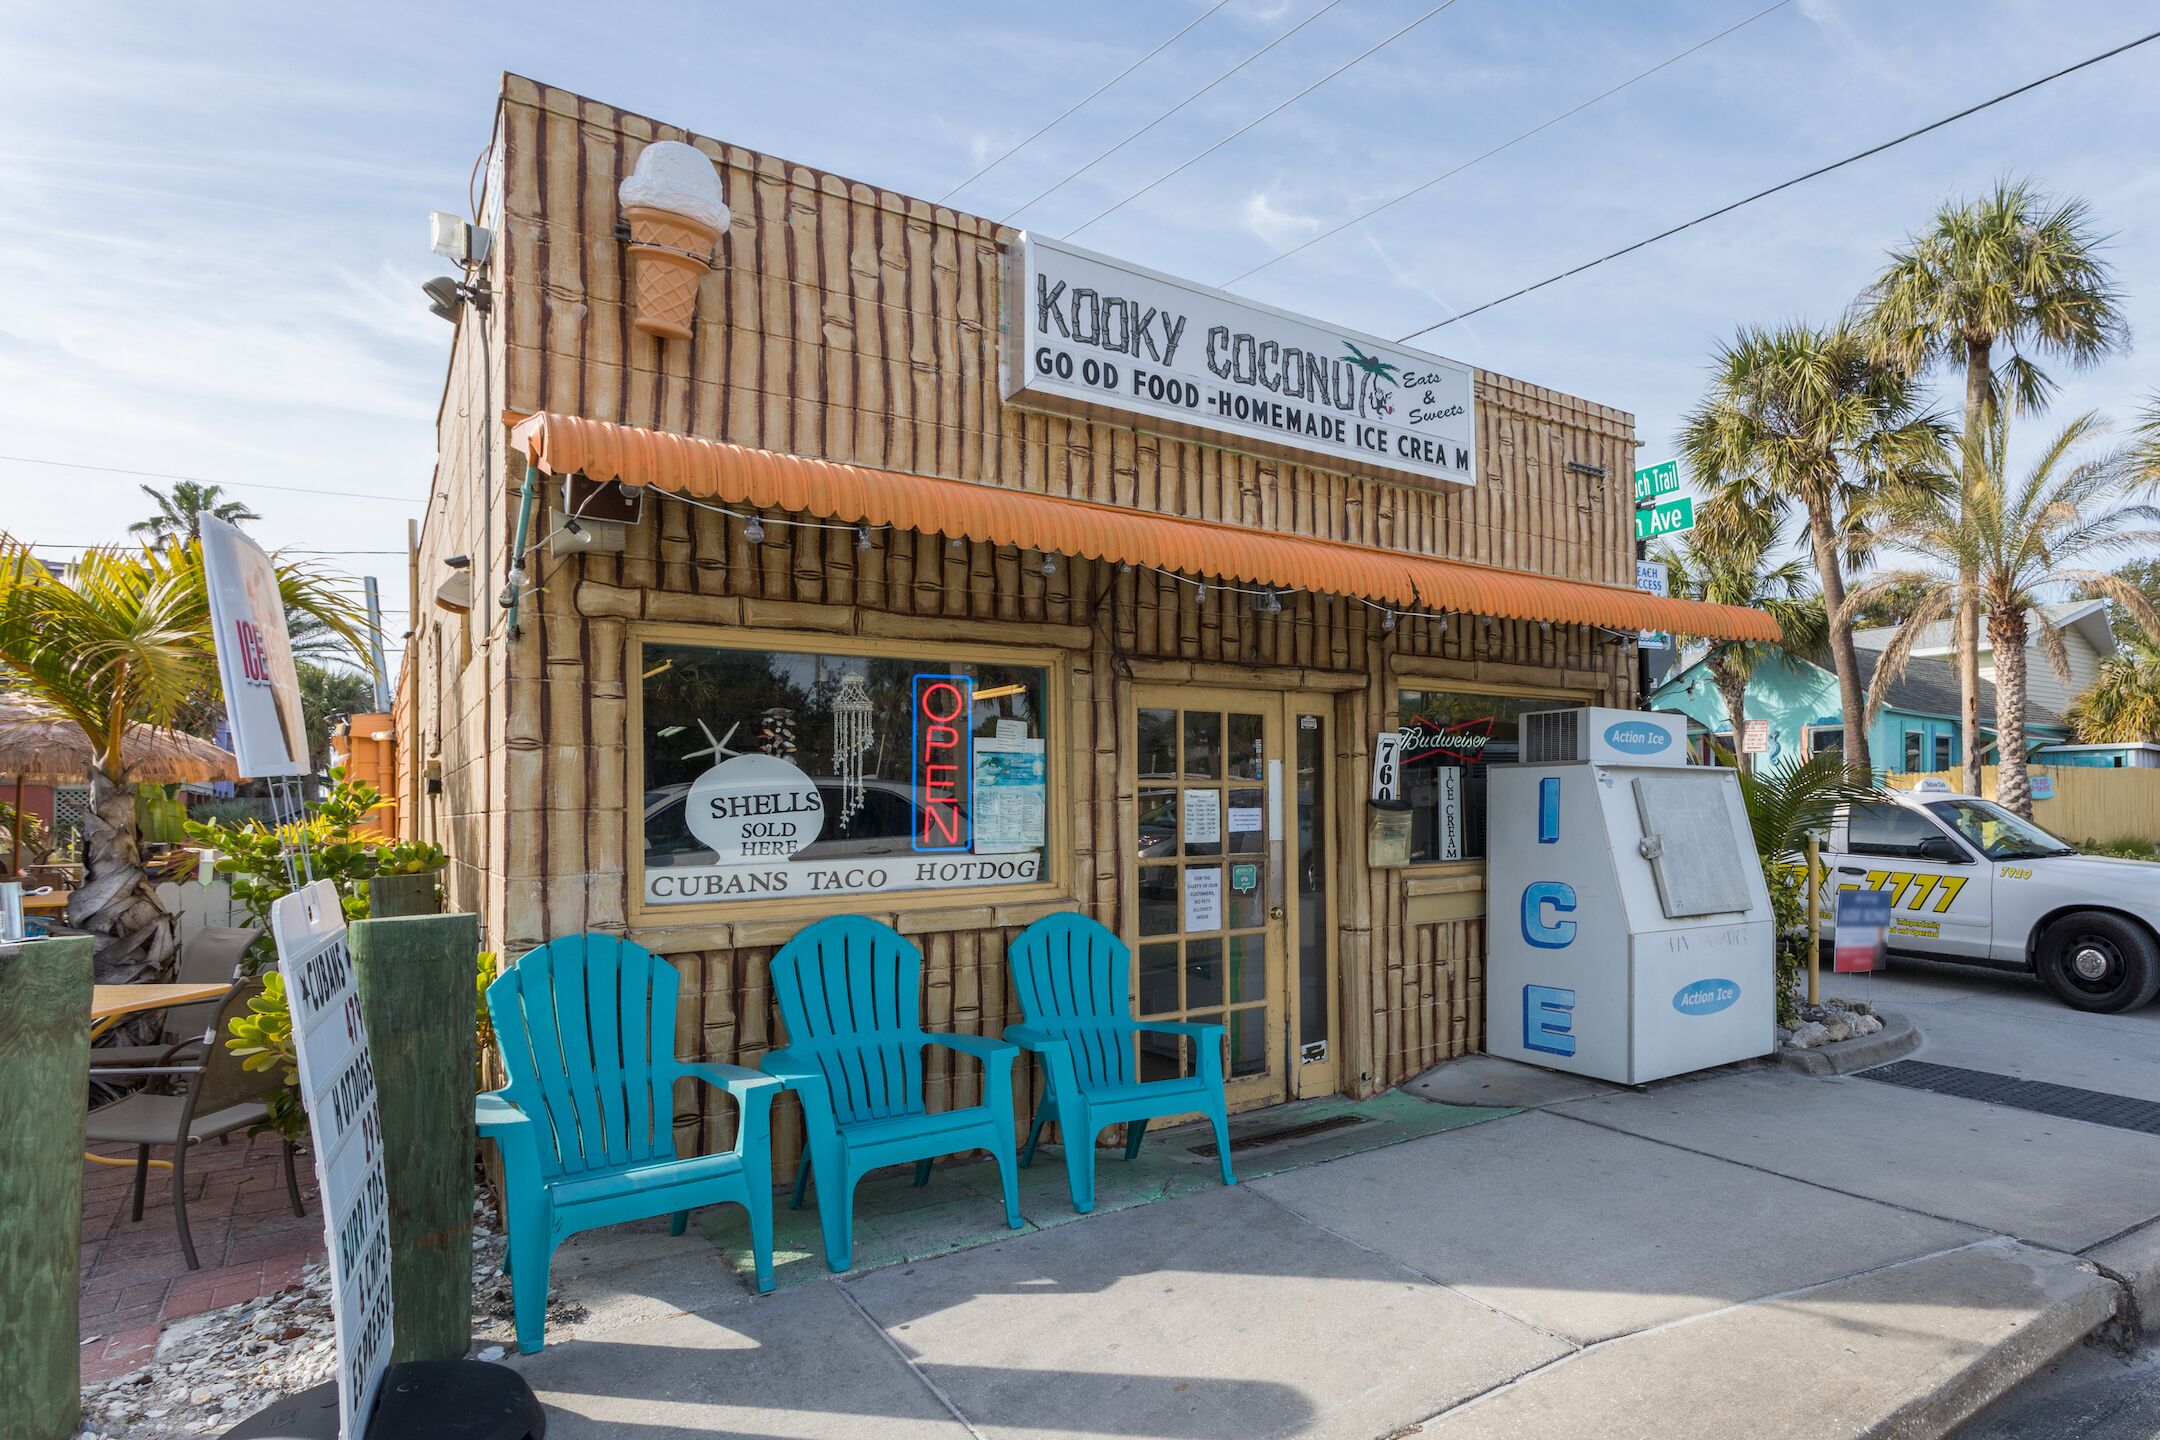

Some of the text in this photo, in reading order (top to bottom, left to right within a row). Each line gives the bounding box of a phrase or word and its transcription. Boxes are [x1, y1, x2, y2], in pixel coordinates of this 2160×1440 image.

[1037, 273, 1187, 367] KOOKY
[1402, 371, 1442, 389] Eats
[1133, 369, 1199, 408] FOOD
[1356, 423, 1388, 453] ICE
[1423, 389, 1436, 405] &
[1409, 404, 1466, 425] Sweets
[1652, 464, 1678, 492] Trail
[1650, 509, 1682, 534] Ave
[1637, 566, 1658, 579] EACH
[1637, 578, 1662, 591] CCESS
[236, 619, 269, 681] ICE
[1398, 726, 1490, 751] Budweiser
[1612, 730, 1664, 745] Action Ice
[921, 682, 963, 845] OPEN
[1378, 743, 1395, 800] 760
[710, 791, 821, 819] SHELLS
[1445, 767, 1457, 858] ICE CREAM
[741, 822, 797, 839] SOLD
[740, 840, 798, 857] HERE
[650, 860, 1036, 897] CUBANS TACO HOTDOG
[2000, 866, 2032, 880] 7920
[1520, 777, 1577, 1057] ICE
[1909, 928, 1940, 938] Operated
[306, 942, 346, 1012] CUBANS
[1681, 988, 1734, 1007] Action Ice
[331, 1046, 374, 1137] HOTDOGS
[341, 1159, 384, 1281] BURRITOS
[365, 1219, 387, 1301] CHIPS
[352, 1273, 390, 1412] ESPRESSO
